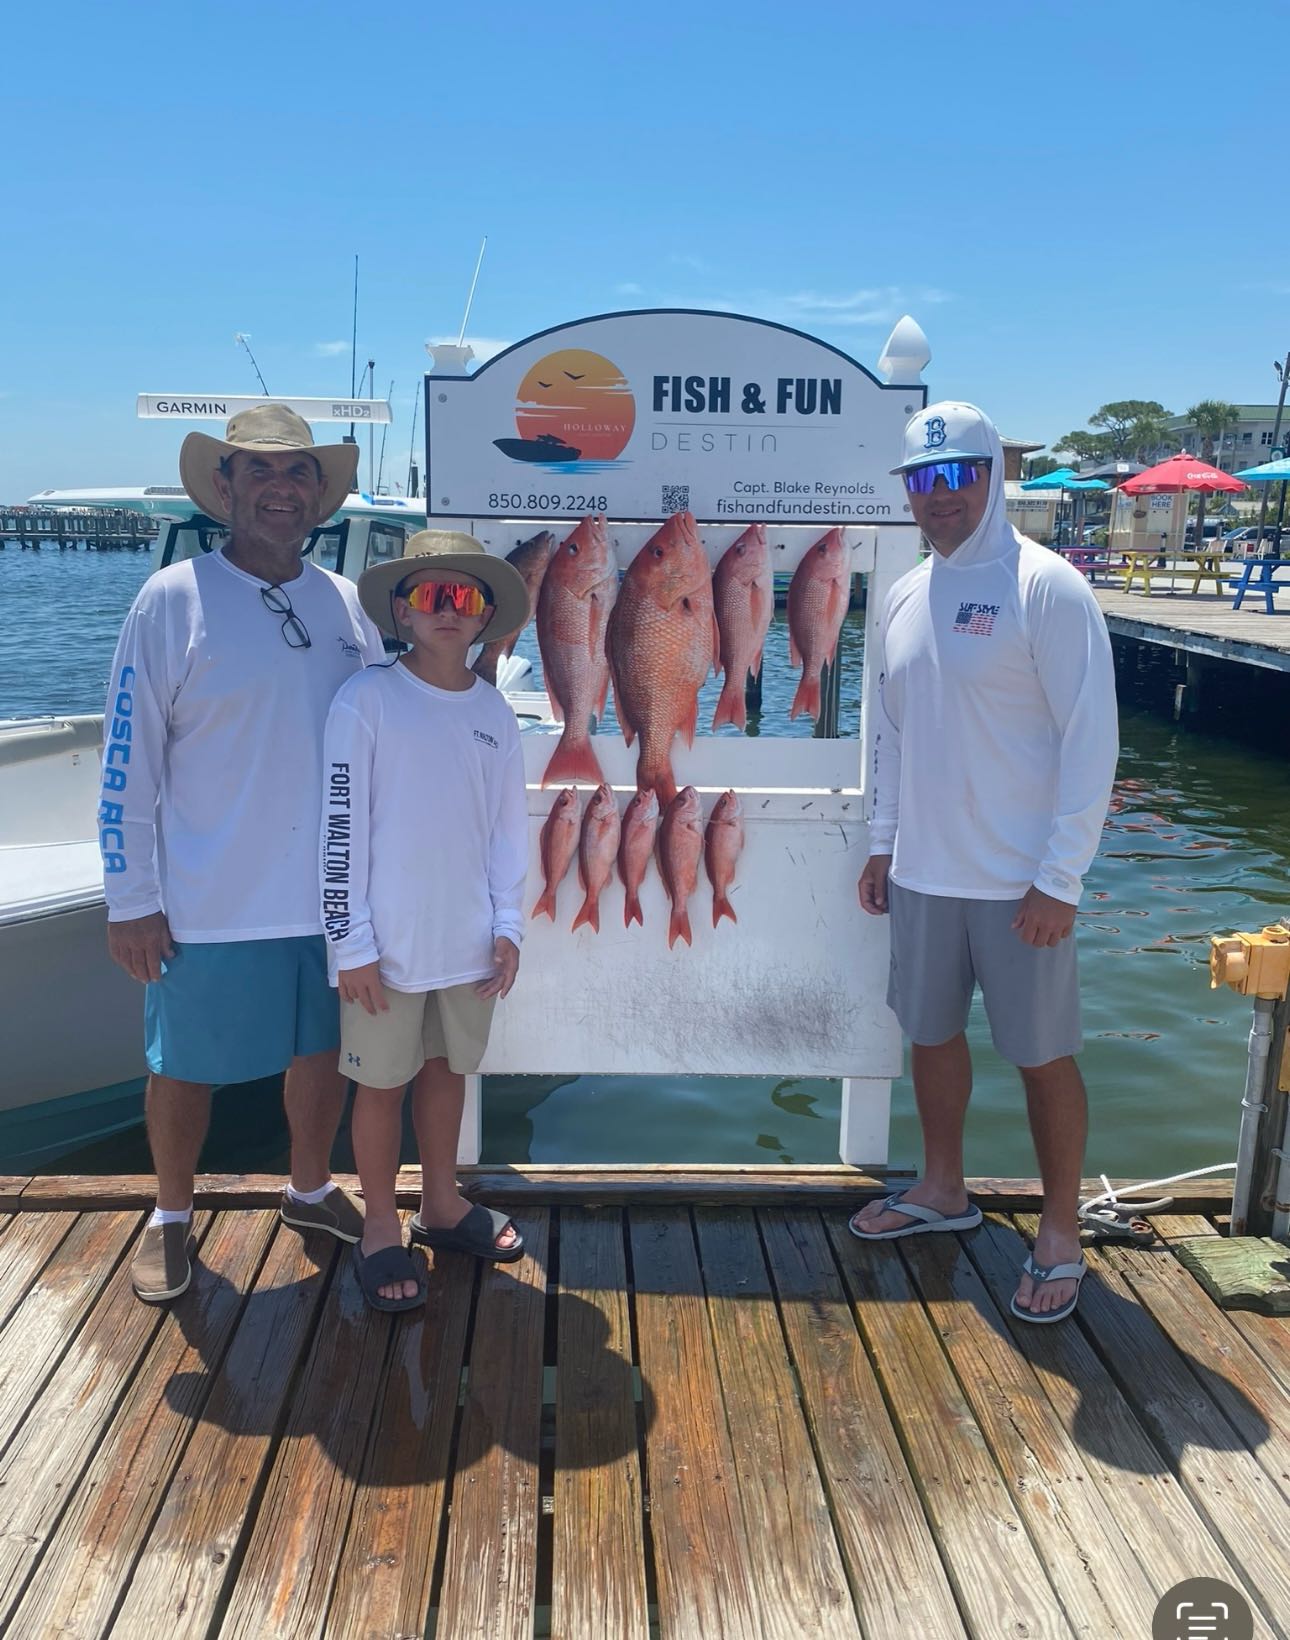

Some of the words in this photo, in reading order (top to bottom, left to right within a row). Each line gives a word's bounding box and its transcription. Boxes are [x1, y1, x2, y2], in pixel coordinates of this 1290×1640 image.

[156, 402, 227, 414] GARMIN
[653, 376, 731, 413] FISH
[741, 382, 766, 414] &
[776, 378, 842, 415] FUN
[563, 423, 626, 432] HOLLOWAY
[924, 416, 947, 448] B
[733, 481, 769, 496] Capt.
[774, 482, 811, 494] Blake
[815, 482, 875, 497] Reynolds
[488, 493, 608, 511] 850.809.2248
[716, 499, 891, 515] fishandfundestin.com
[329, 763, 351, 809] FORT
[325, 814, 351, 884] WALTON
[323, 888, 351, 943] BEACH
